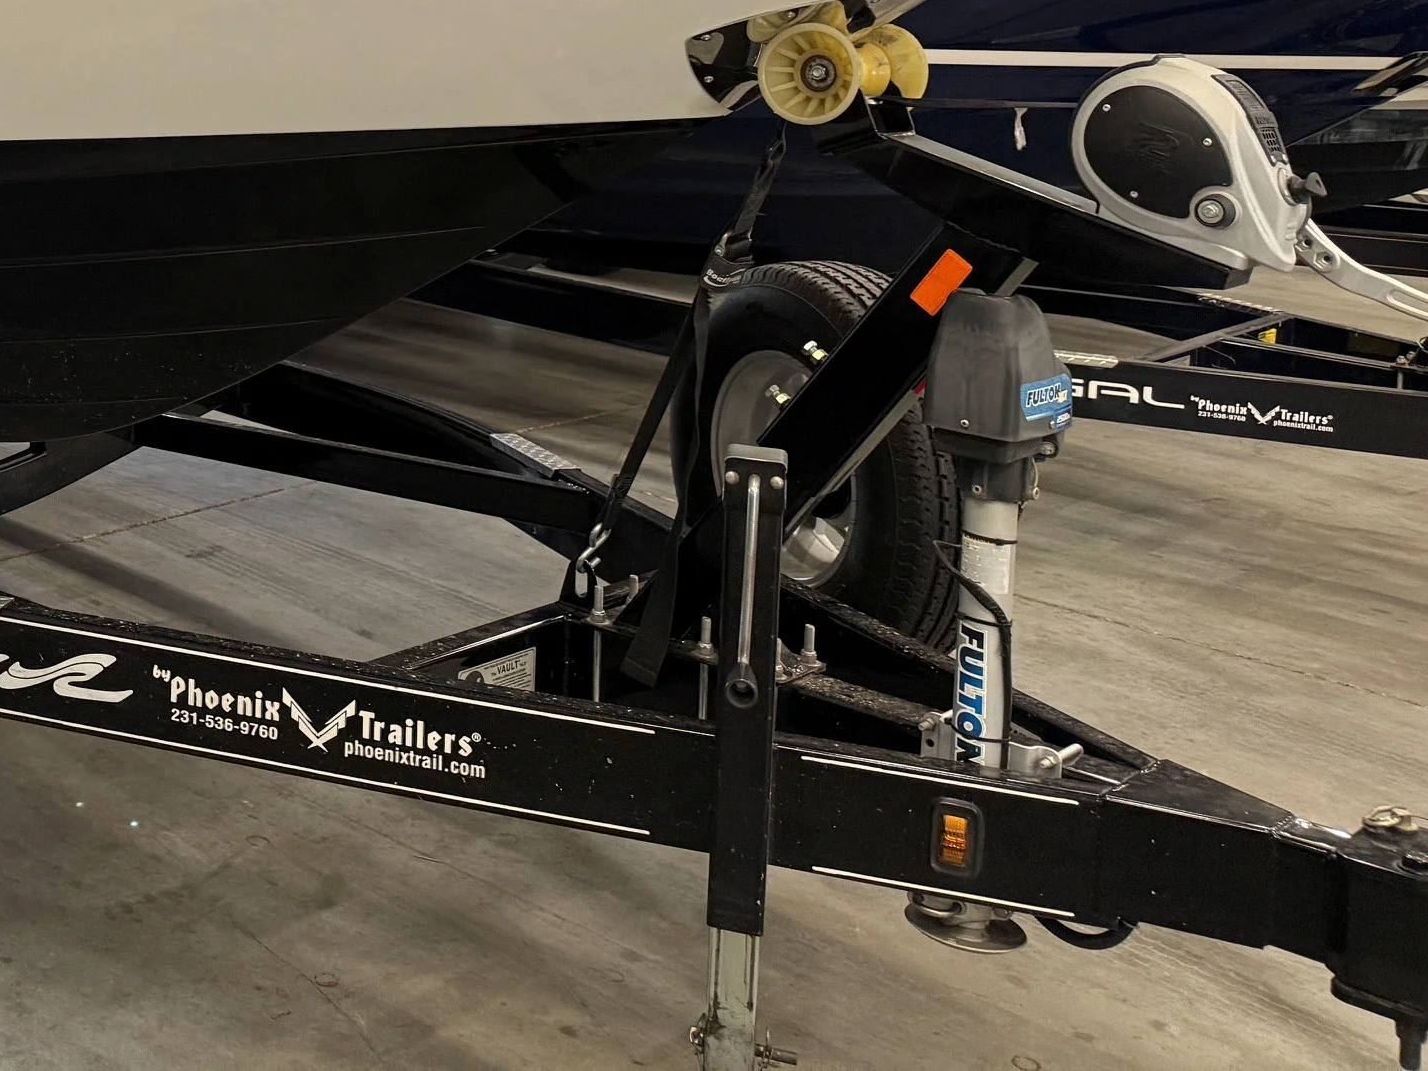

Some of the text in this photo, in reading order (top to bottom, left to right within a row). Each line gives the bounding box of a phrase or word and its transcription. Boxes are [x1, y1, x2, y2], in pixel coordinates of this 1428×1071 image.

[1026, 383, 1062, 407] FULTON
[1072, 378, 1185, 409] AL
[1198, 399, 1248, 415] Phoenix
[152, 664, 171, 682] by
[171, 676, 280, 722] Phoenix
[955, 620, 987, 765] FULTON
[171, 707, 279, 741] 231-536-9760
[344, 739, 487, 779] phoenixtrail.com
